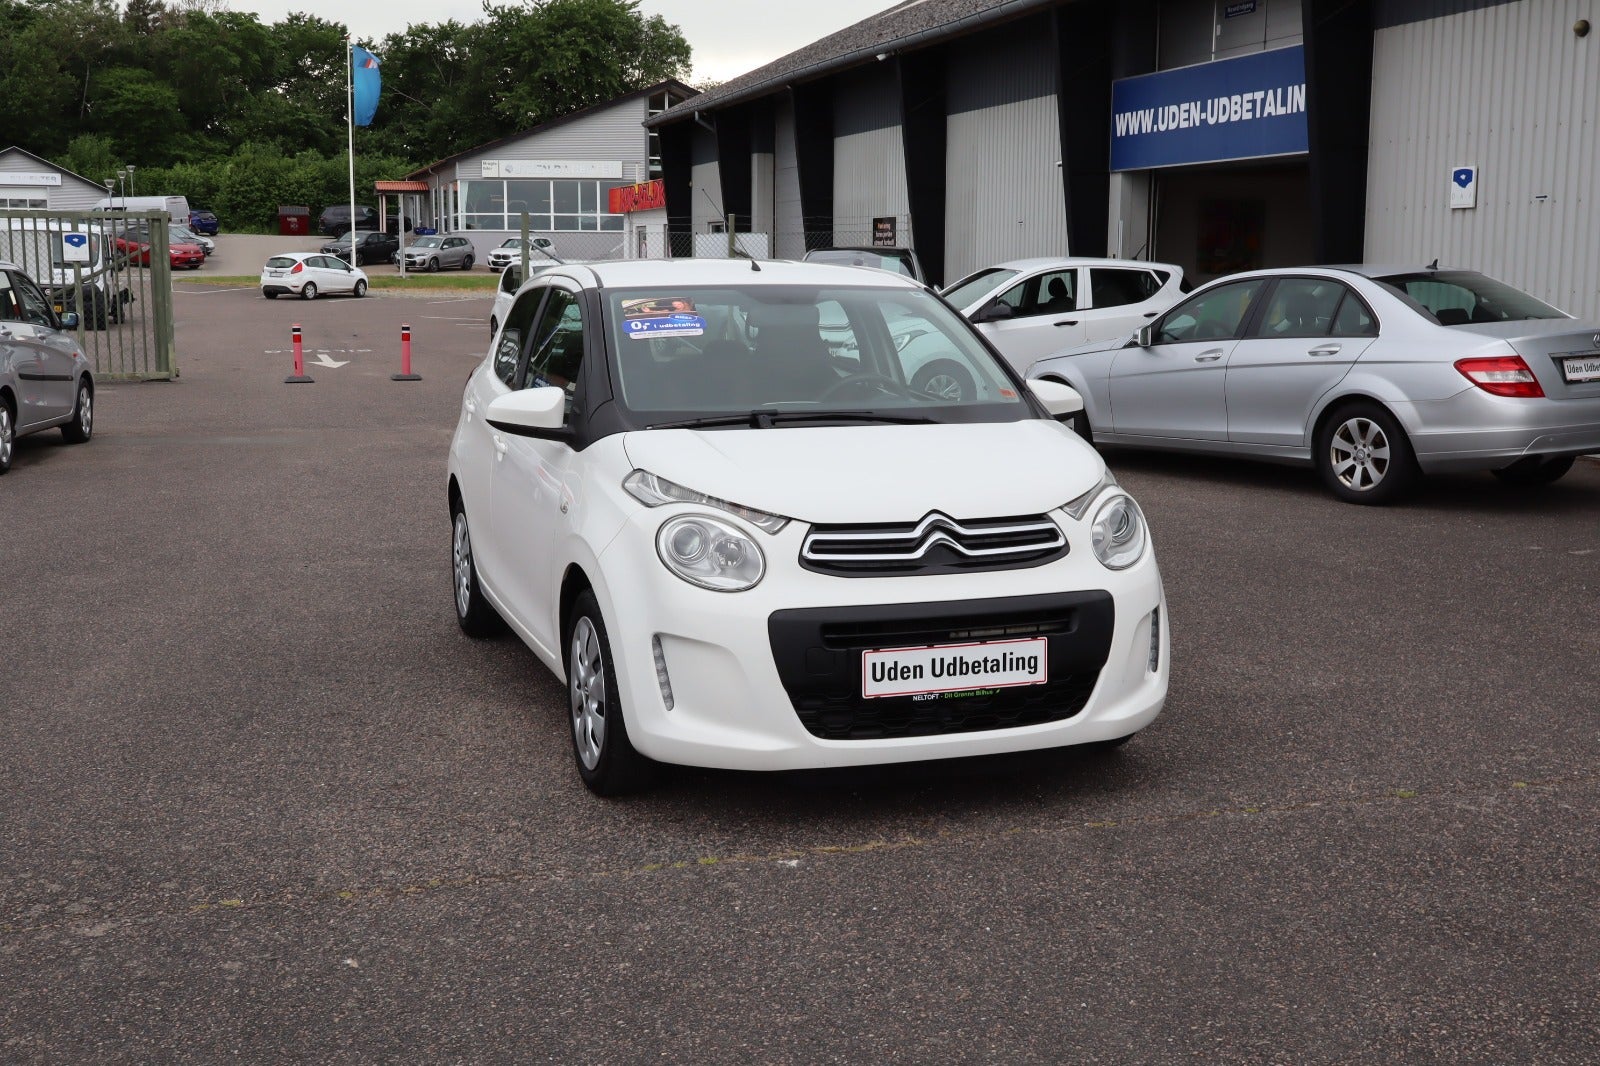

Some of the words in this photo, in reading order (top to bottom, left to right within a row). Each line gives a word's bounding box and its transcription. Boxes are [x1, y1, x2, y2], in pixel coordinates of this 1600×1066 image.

[1115, 83, 1306, 137] WWW.UDEN-UDBETALIN
[1566, 363, 1583, 373] Uden
[871, 660, 924, 683] Uden
[931, 652, 1038, 678] Udbetaling
[912, 693, 940, 701] NELTOFT
